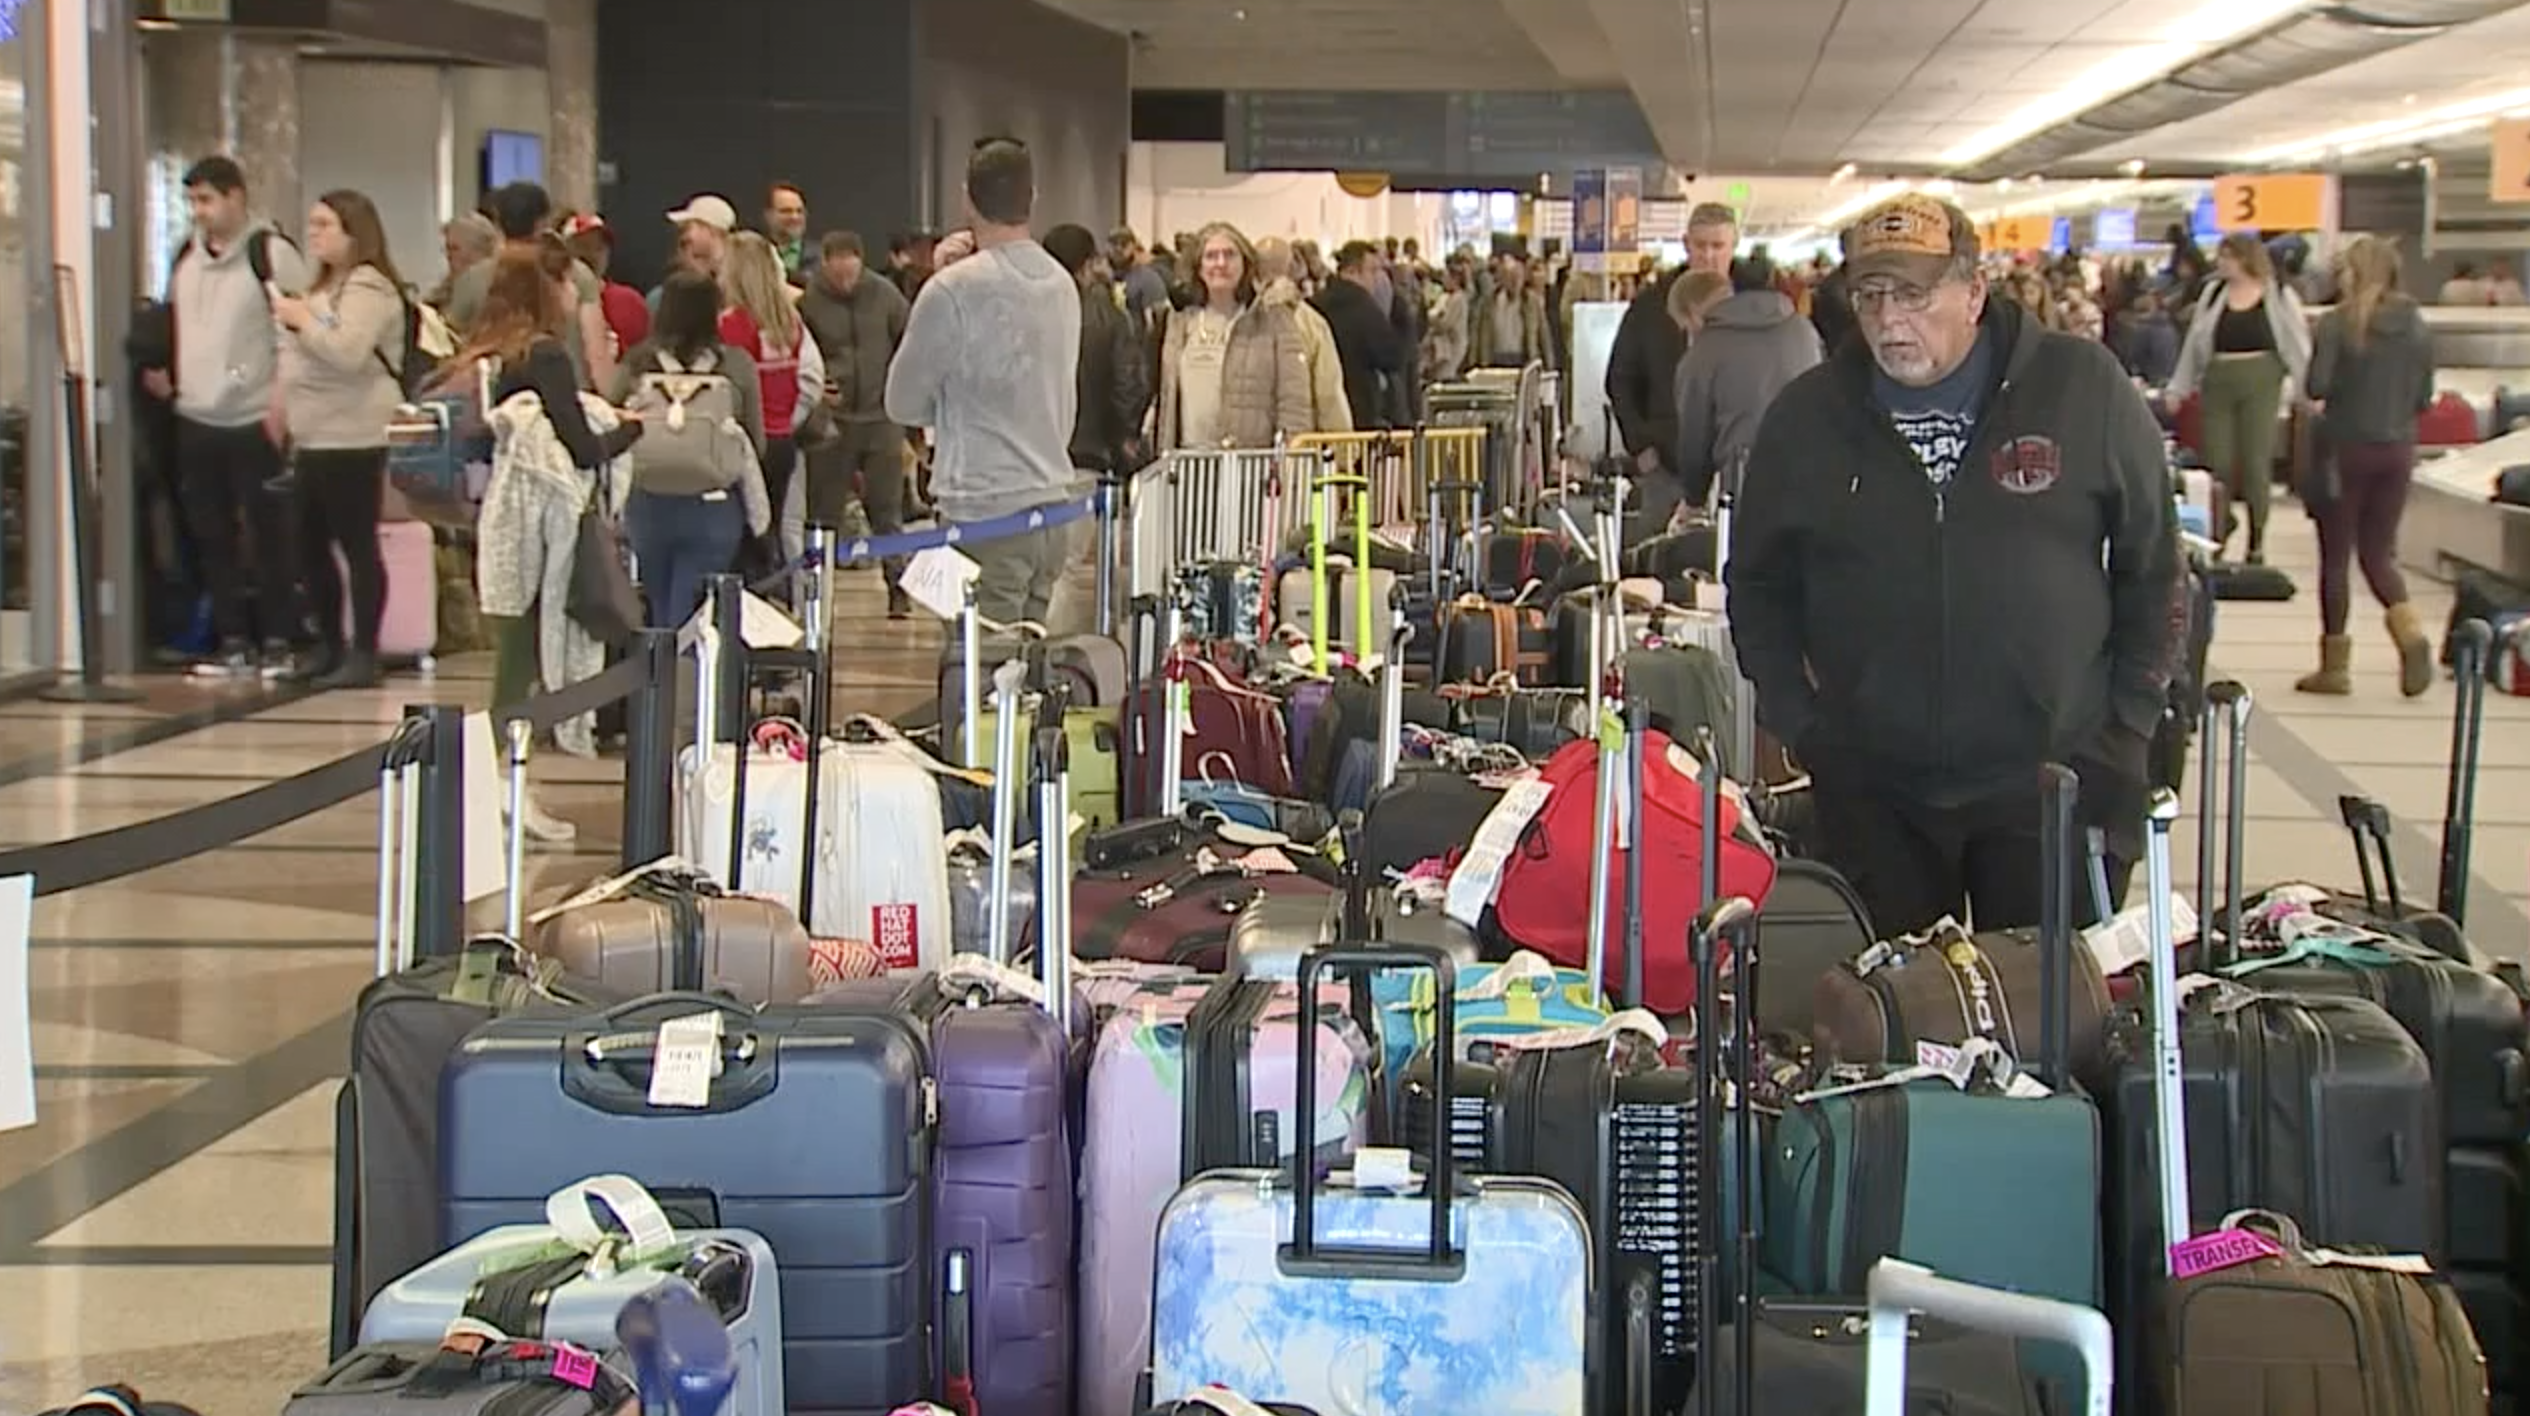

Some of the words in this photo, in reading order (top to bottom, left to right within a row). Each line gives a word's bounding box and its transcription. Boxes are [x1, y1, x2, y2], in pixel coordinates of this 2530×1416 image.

[2233, 185, 2257, 222] 3
[880, 906, 911, 918] RED
[881, 918, 912, 931] HAT
[881, 931, 912, 944] DOT
[882, 944, 912, 958] COM
